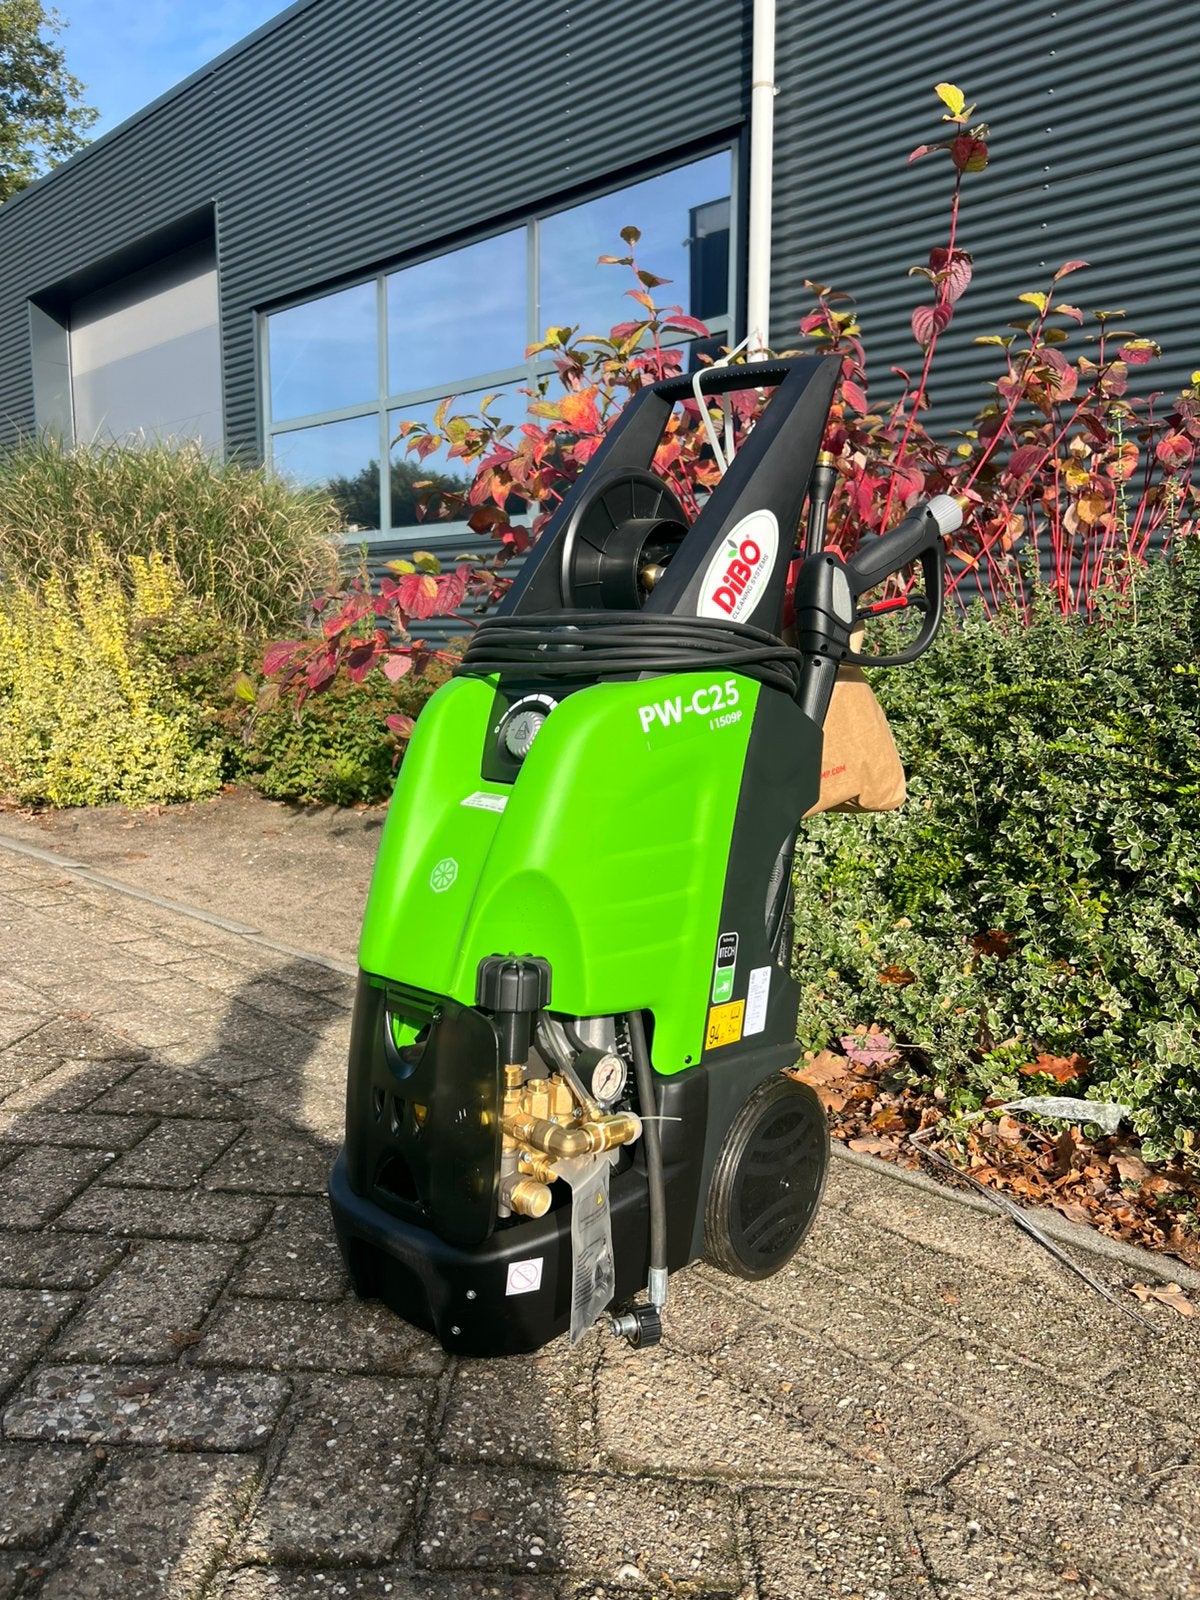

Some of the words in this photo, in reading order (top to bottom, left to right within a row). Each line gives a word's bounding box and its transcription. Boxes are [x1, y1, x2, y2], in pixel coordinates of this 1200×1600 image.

[732, 584, 753, 620] CLEANING
[751, 553, 769, 586] SYSTEMS
[638, 679, 739, 733] PW-C25
